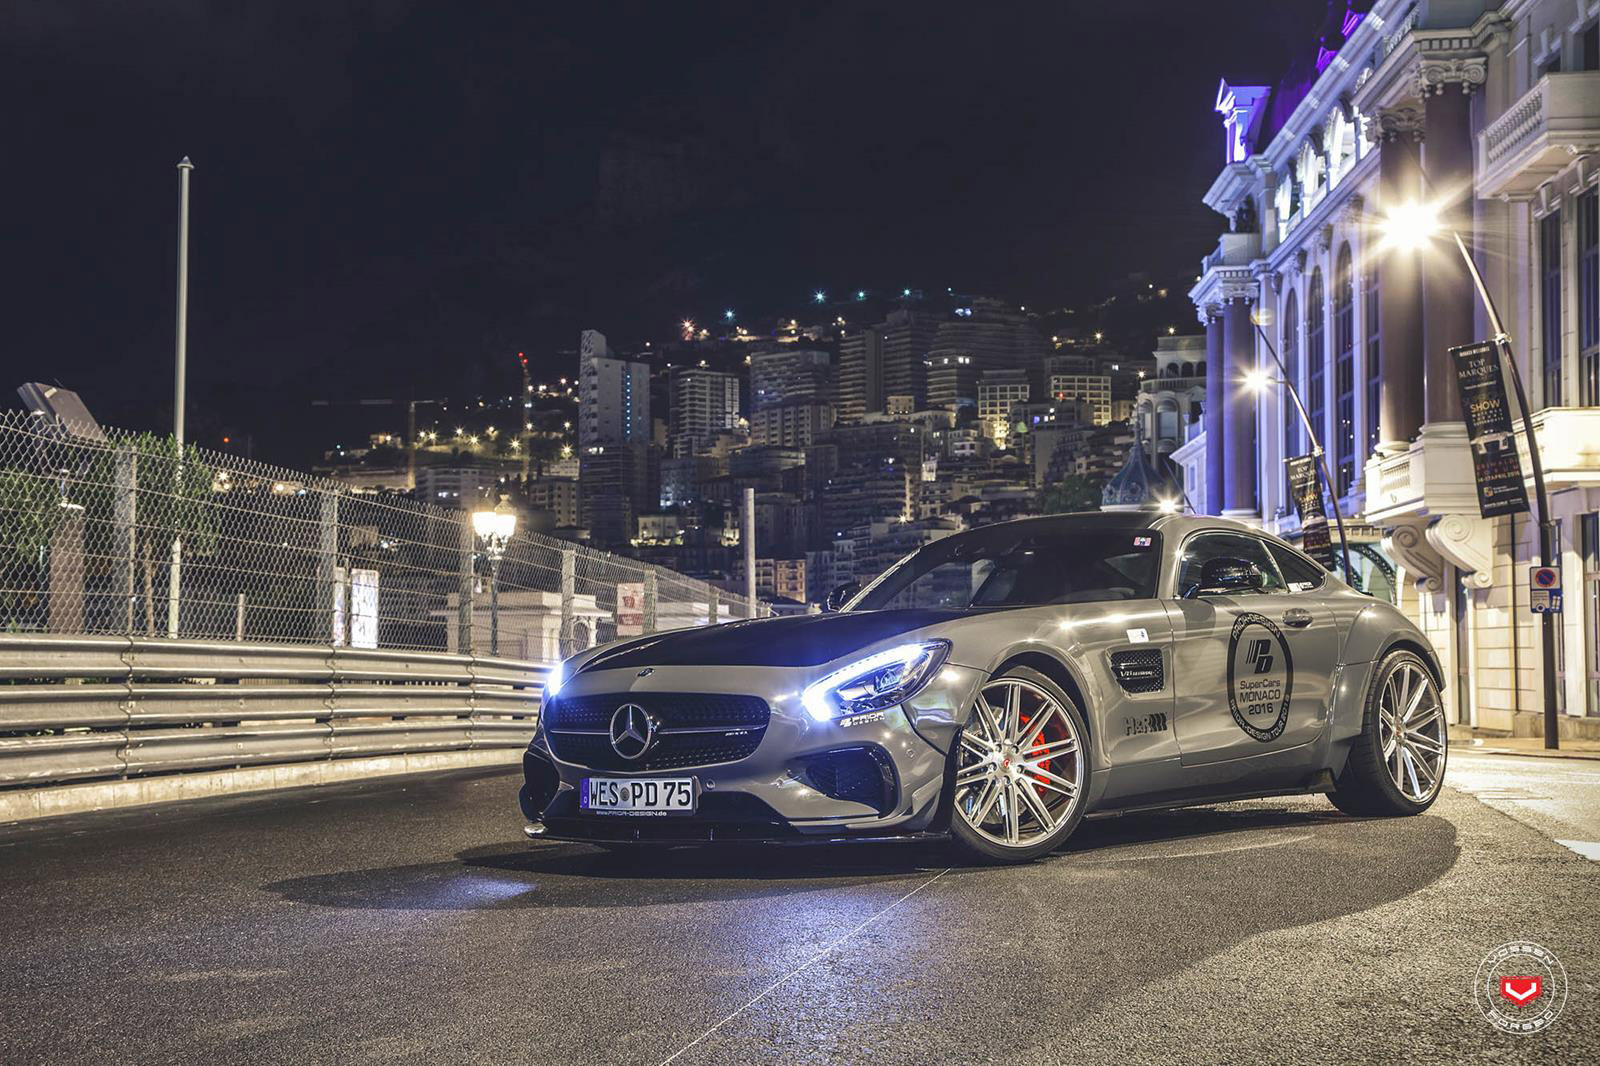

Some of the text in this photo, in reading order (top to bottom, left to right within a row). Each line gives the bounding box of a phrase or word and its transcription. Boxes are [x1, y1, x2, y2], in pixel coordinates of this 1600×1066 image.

[1468, 358, 1485, 369] TOP
[1470, 399, 1501, 413] SHOW
[1240, 678, 1281, 690] SuperCars
[1240, 689, 1281, 703] MONACO
[1248, 702, 1274, 716] 2016
[852, 711, 885, 723] PRIOR
[1122, 713, 1153, 736] H&R
[590, 781, 691, 807] WES PD 75
